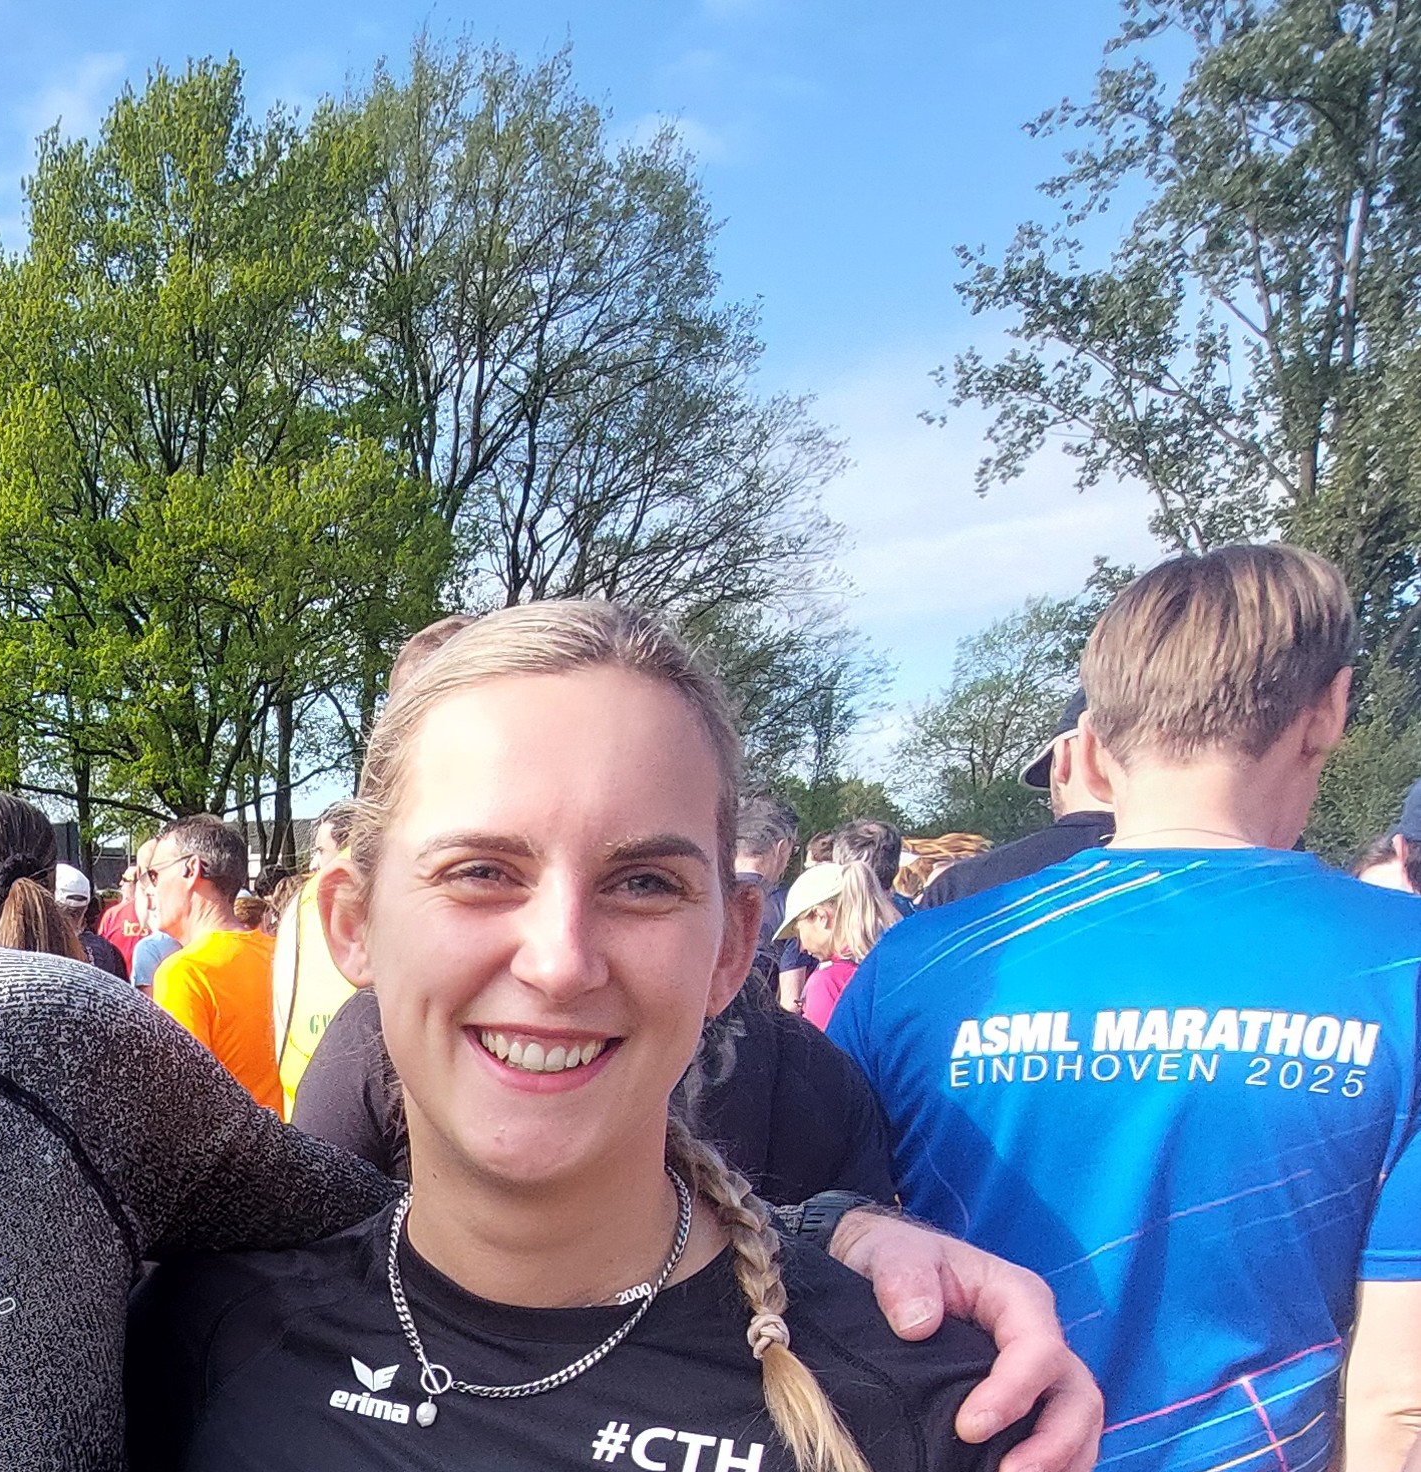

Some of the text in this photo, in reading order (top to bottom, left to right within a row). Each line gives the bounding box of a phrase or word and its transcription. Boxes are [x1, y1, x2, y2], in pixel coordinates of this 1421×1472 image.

[950, 1009, 1380, 1066] ASML MARATHON
[950, 1054, 1367, 1097] EINDHOVEN 2025
[614, 1282, 652, 1305] 2000
[329, 1389, 410, 1424] erima
